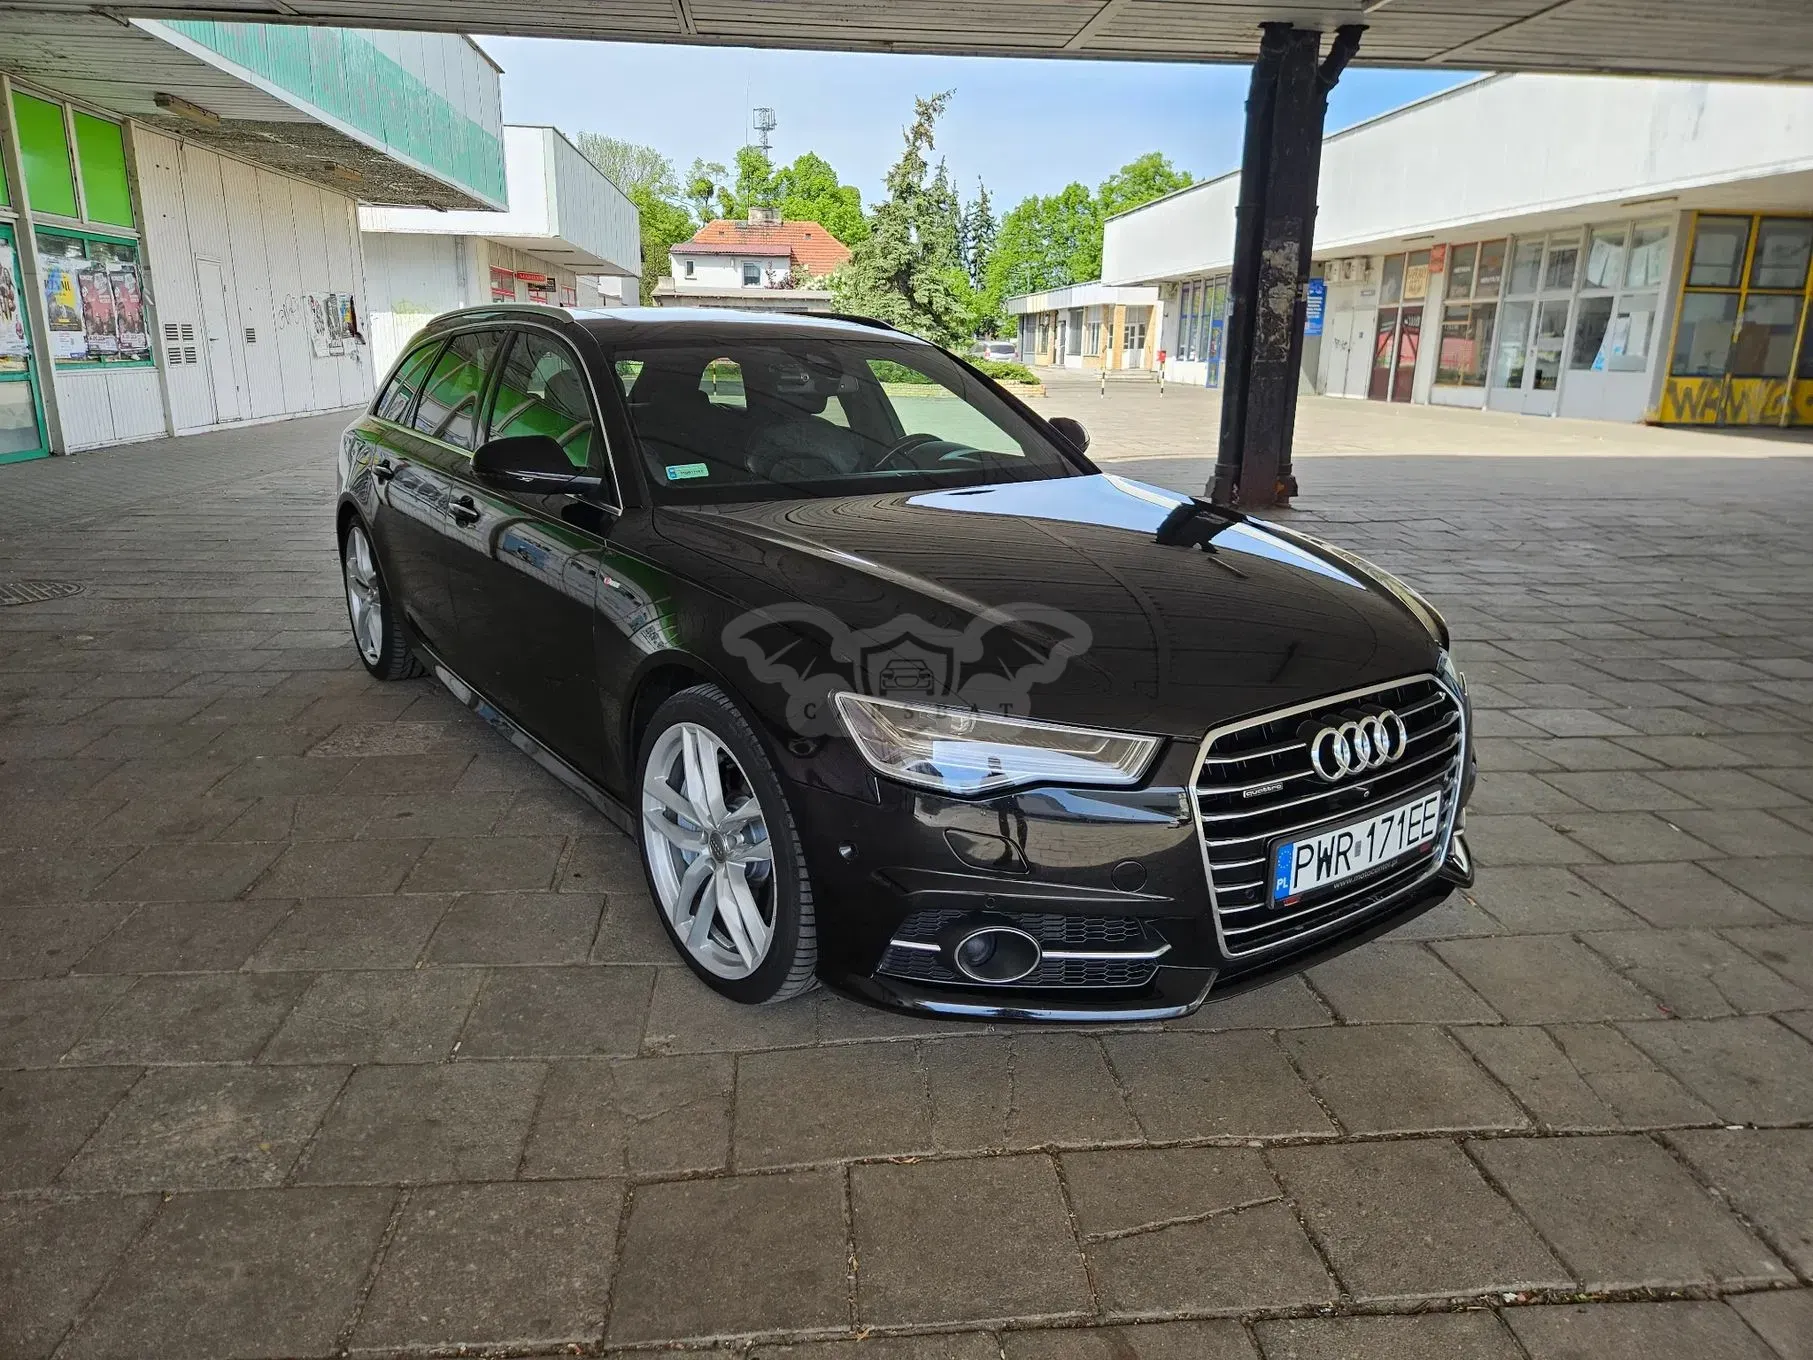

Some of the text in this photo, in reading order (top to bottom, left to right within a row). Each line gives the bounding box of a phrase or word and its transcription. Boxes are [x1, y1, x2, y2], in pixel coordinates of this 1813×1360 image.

[1245, 784, 1282, 797] quattro
[1294, 797, 1438, 888] PWR 171EE
[1276, 878, 1289, 891] PL
